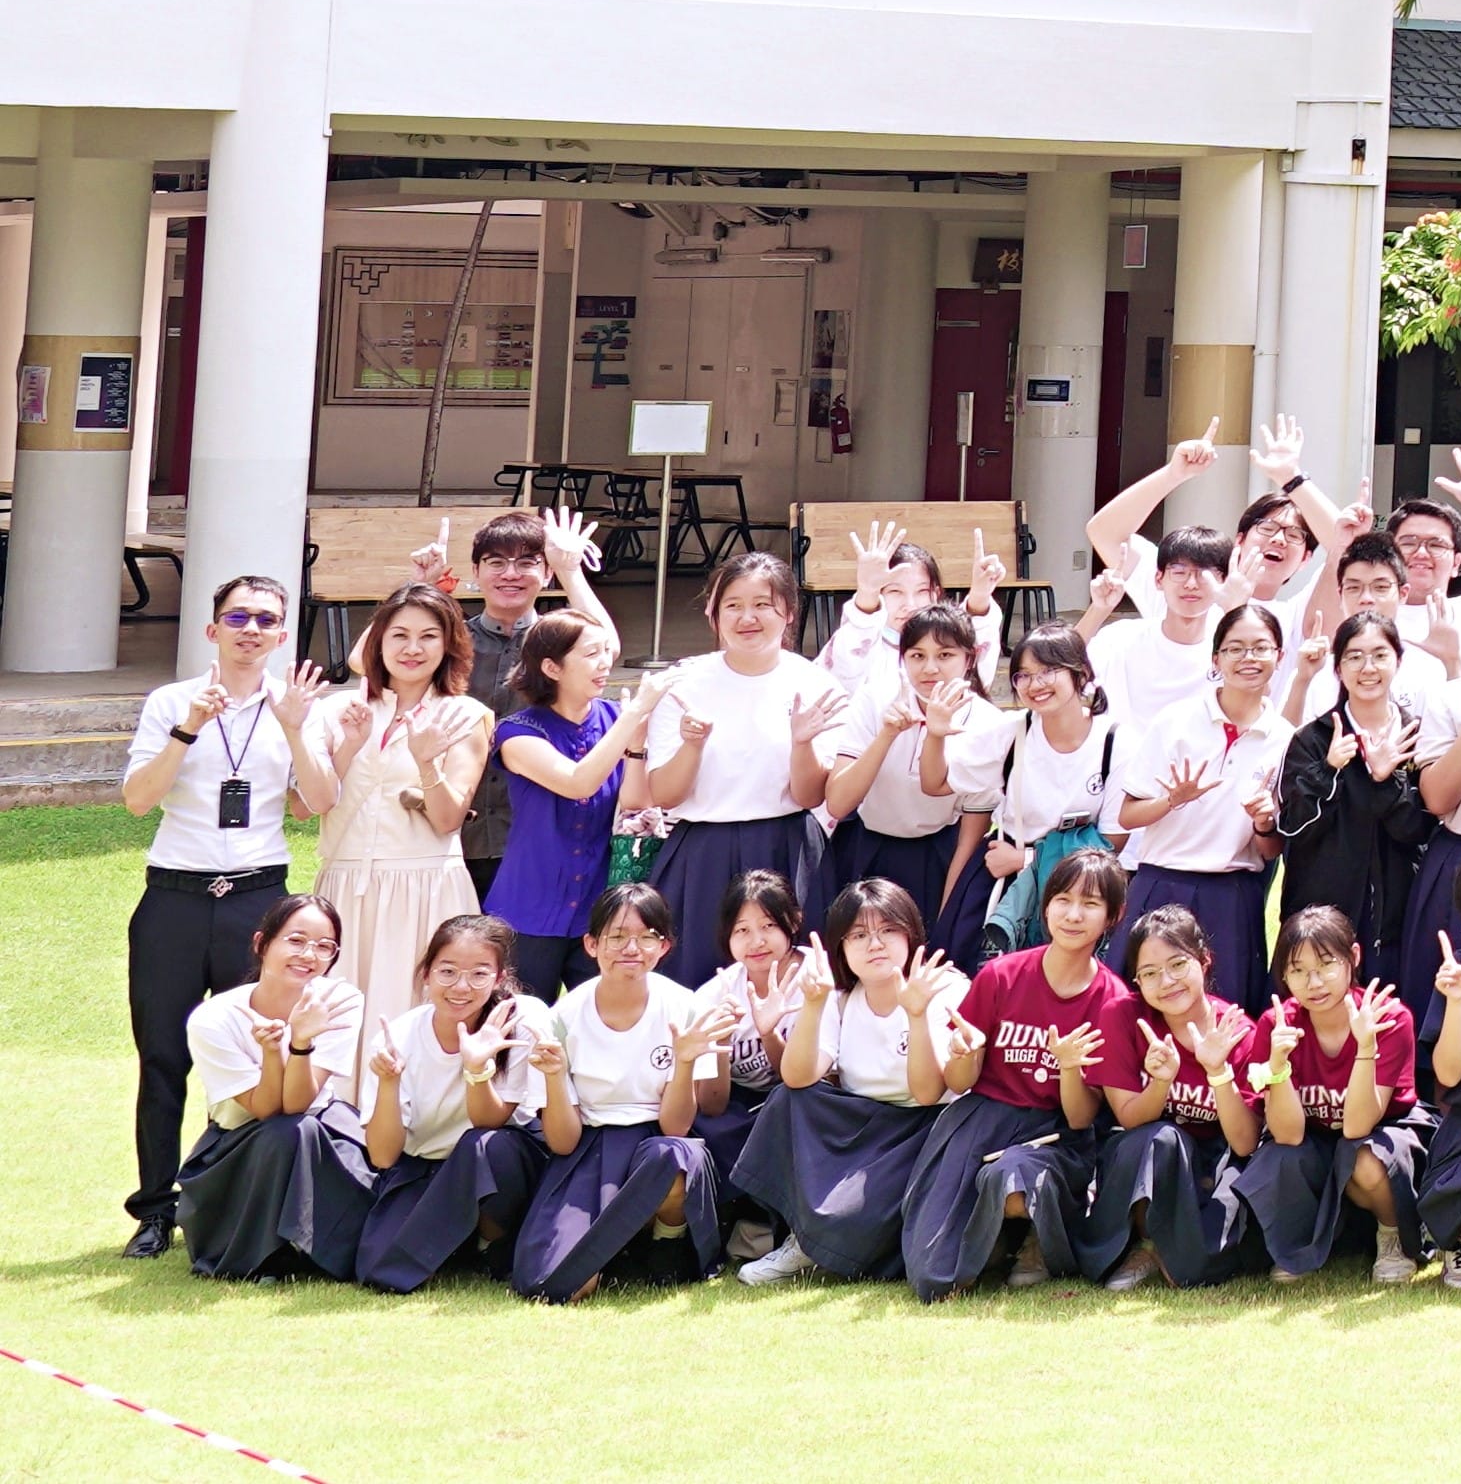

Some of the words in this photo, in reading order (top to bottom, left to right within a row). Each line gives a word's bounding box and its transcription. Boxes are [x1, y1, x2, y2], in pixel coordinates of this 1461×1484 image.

[620, 301, 628, 316] 1
[994, 1020, 1049, 1049] DUN
[1004, 1048, 1039, 1063] HIGH
[1176, 1103, 1218, 1122] SCHOO
